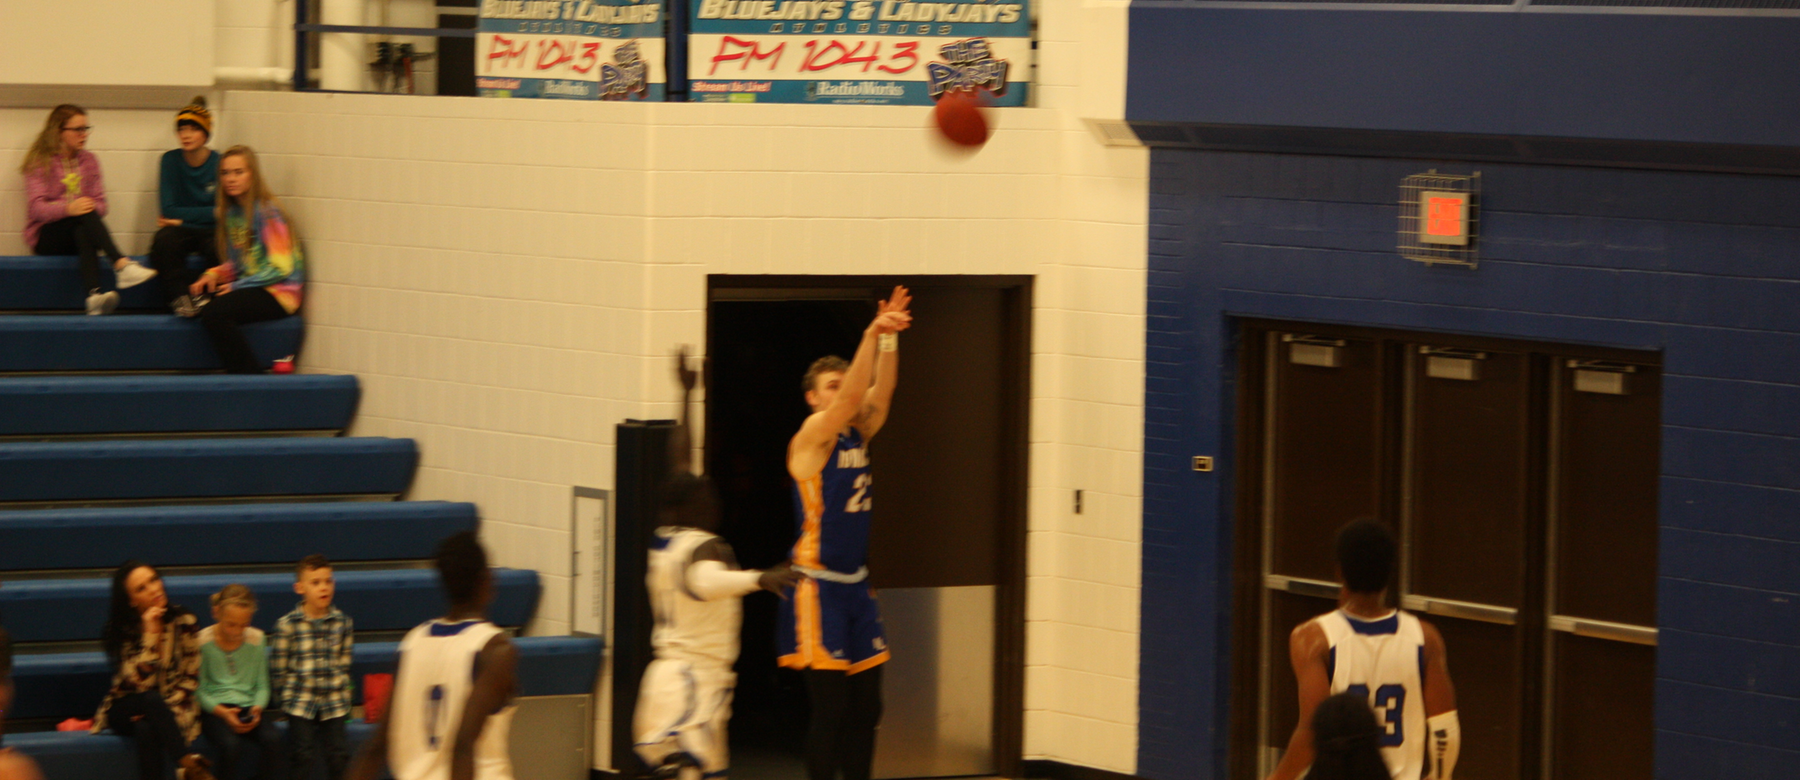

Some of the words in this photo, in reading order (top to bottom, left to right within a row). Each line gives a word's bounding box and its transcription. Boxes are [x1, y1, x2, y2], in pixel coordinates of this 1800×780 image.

[697, 0, 847, 21] BLUEJAYS
[848, 1, 875, 21] &
[877, 0, 1024, 24] LADYJAYS
[708, 35, 787, 76] FM
[1346, 683, 1407, 748] 3
